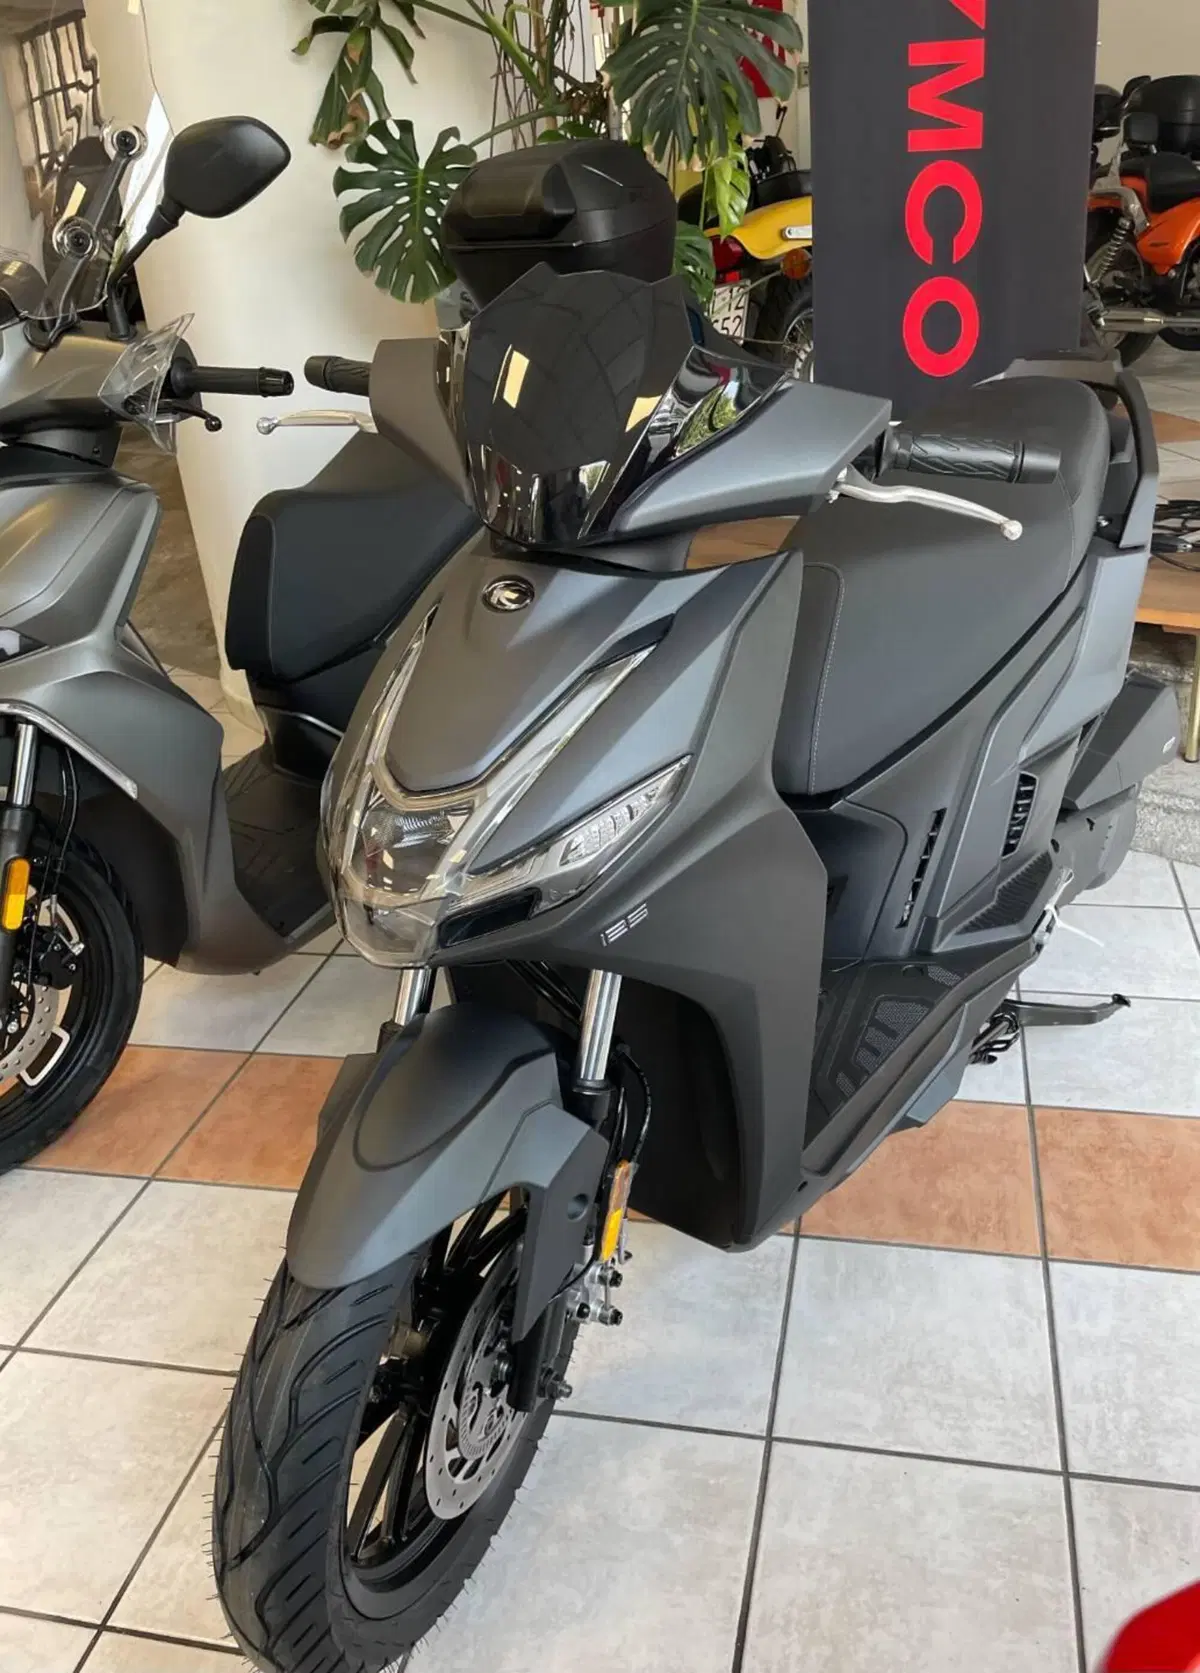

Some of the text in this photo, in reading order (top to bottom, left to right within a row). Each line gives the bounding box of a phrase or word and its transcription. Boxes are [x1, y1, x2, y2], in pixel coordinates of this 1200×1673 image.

[903, 0, 985, 376] MCO
[712, 315, 742, 336] 52
[600, 903, 649, 947] 125
